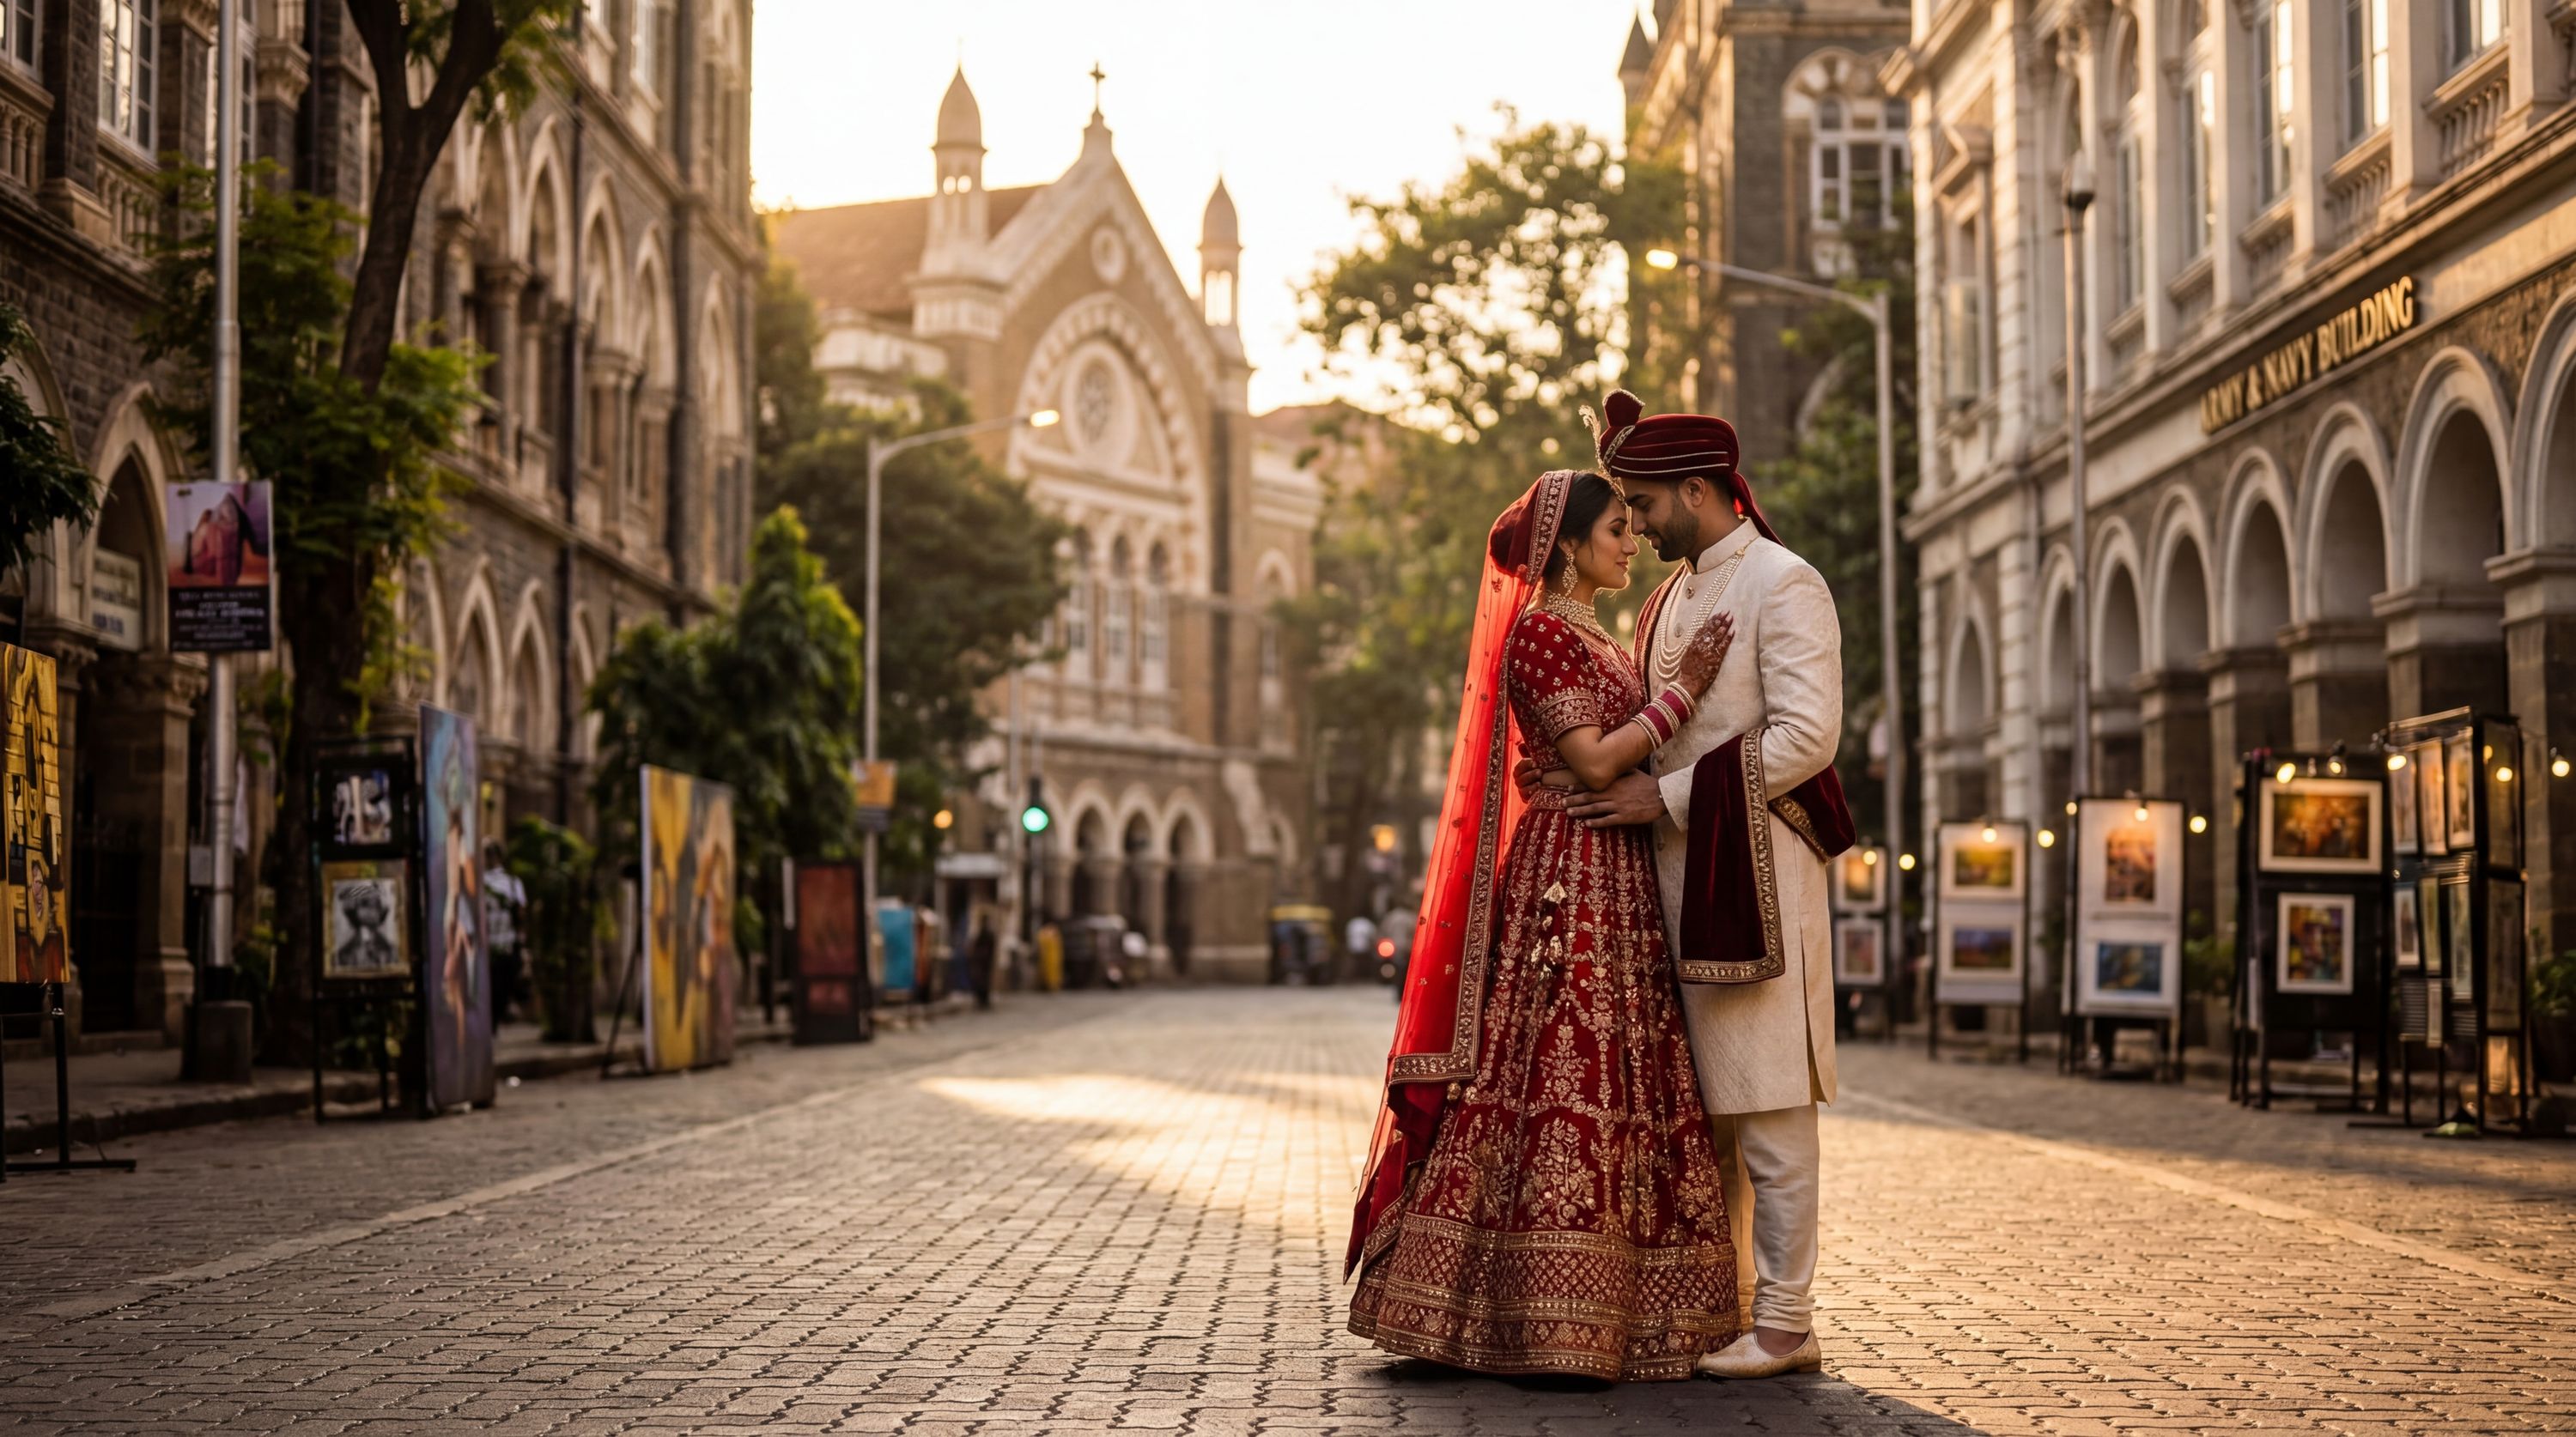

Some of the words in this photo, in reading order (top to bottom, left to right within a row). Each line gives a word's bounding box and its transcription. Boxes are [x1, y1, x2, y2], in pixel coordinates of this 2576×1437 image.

[2247, 364, 2263, 409] &
[2263, 332, 2313, 401] NAVY
[2318, 276, 2413, 372] BUILDING
